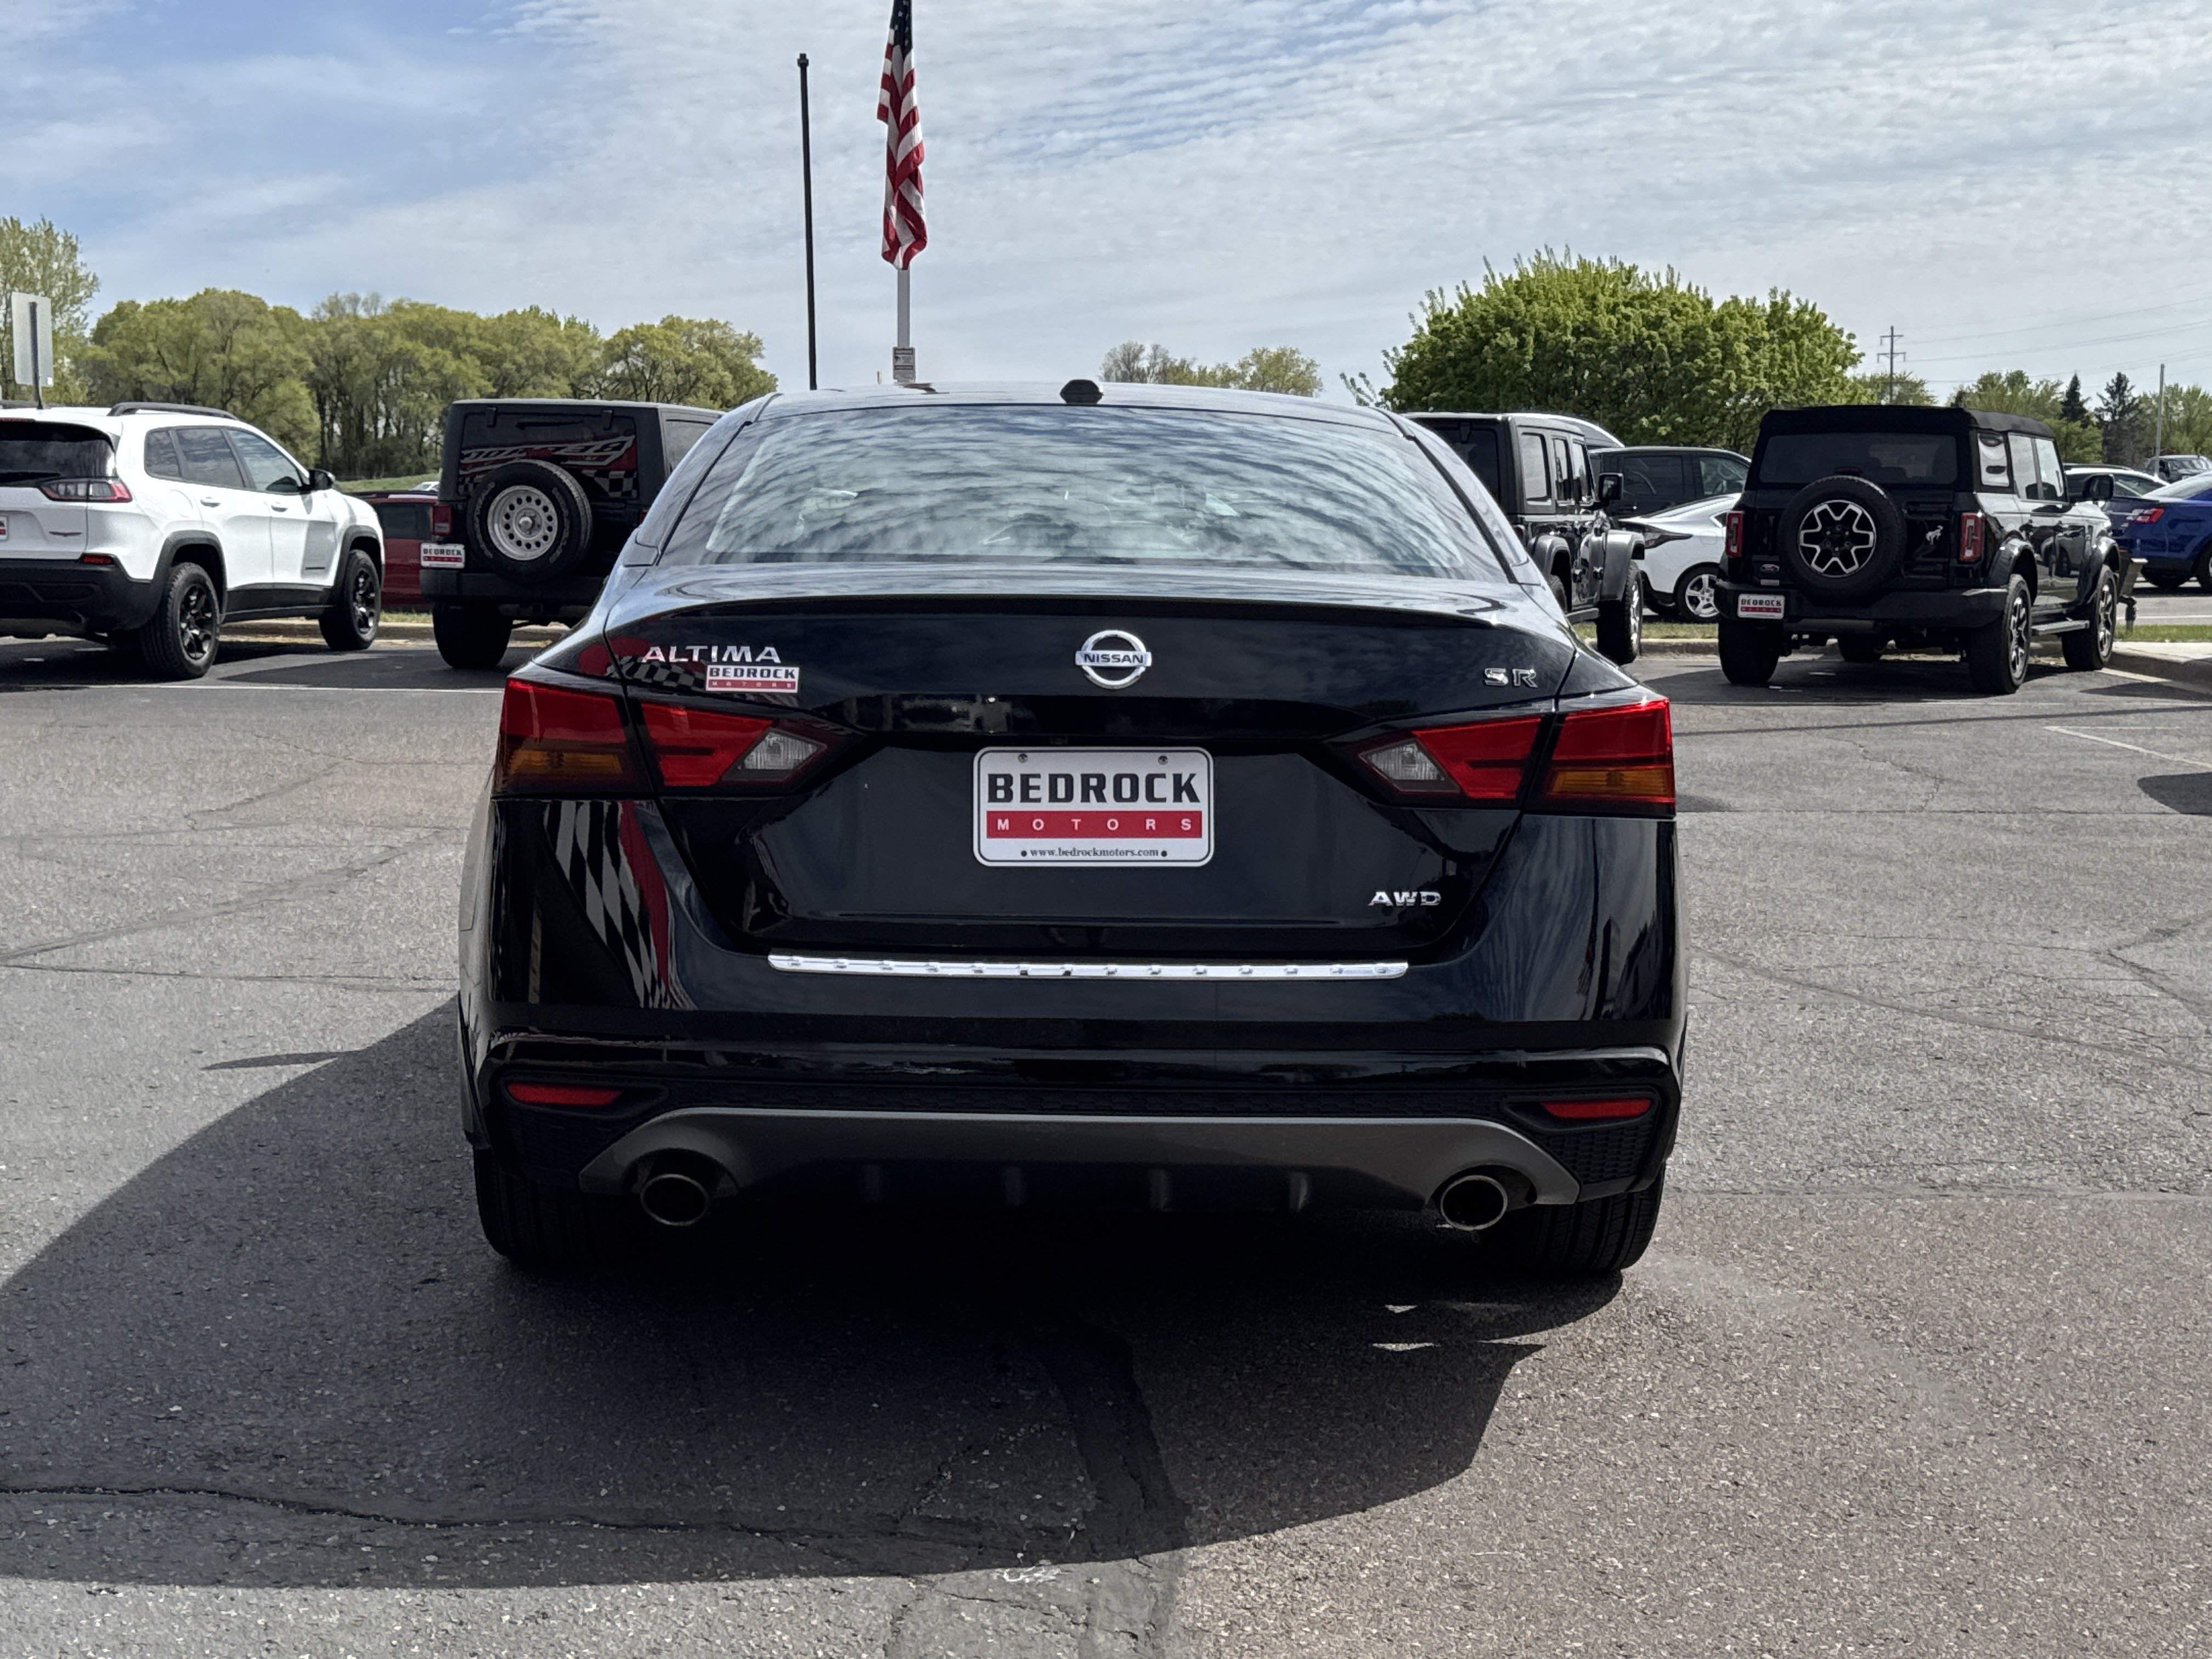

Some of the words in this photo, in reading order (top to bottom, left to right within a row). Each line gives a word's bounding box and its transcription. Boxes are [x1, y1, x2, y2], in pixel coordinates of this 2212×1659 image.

[641, 645, 781, 663] ALTIMA
[1084, 653, 1143, 663] NISSAN
[709, 668, 795, 679] BEDROCK
[1485, 668, 1538, 688] SR
[988, 773, 1200, 803] BEDROCK
[997, 819, 1192, 831] MOTORS
[1030, 848, 1159, 857] www.bedrockmotors.com
[1368, 891, 1441, 906] AWD
